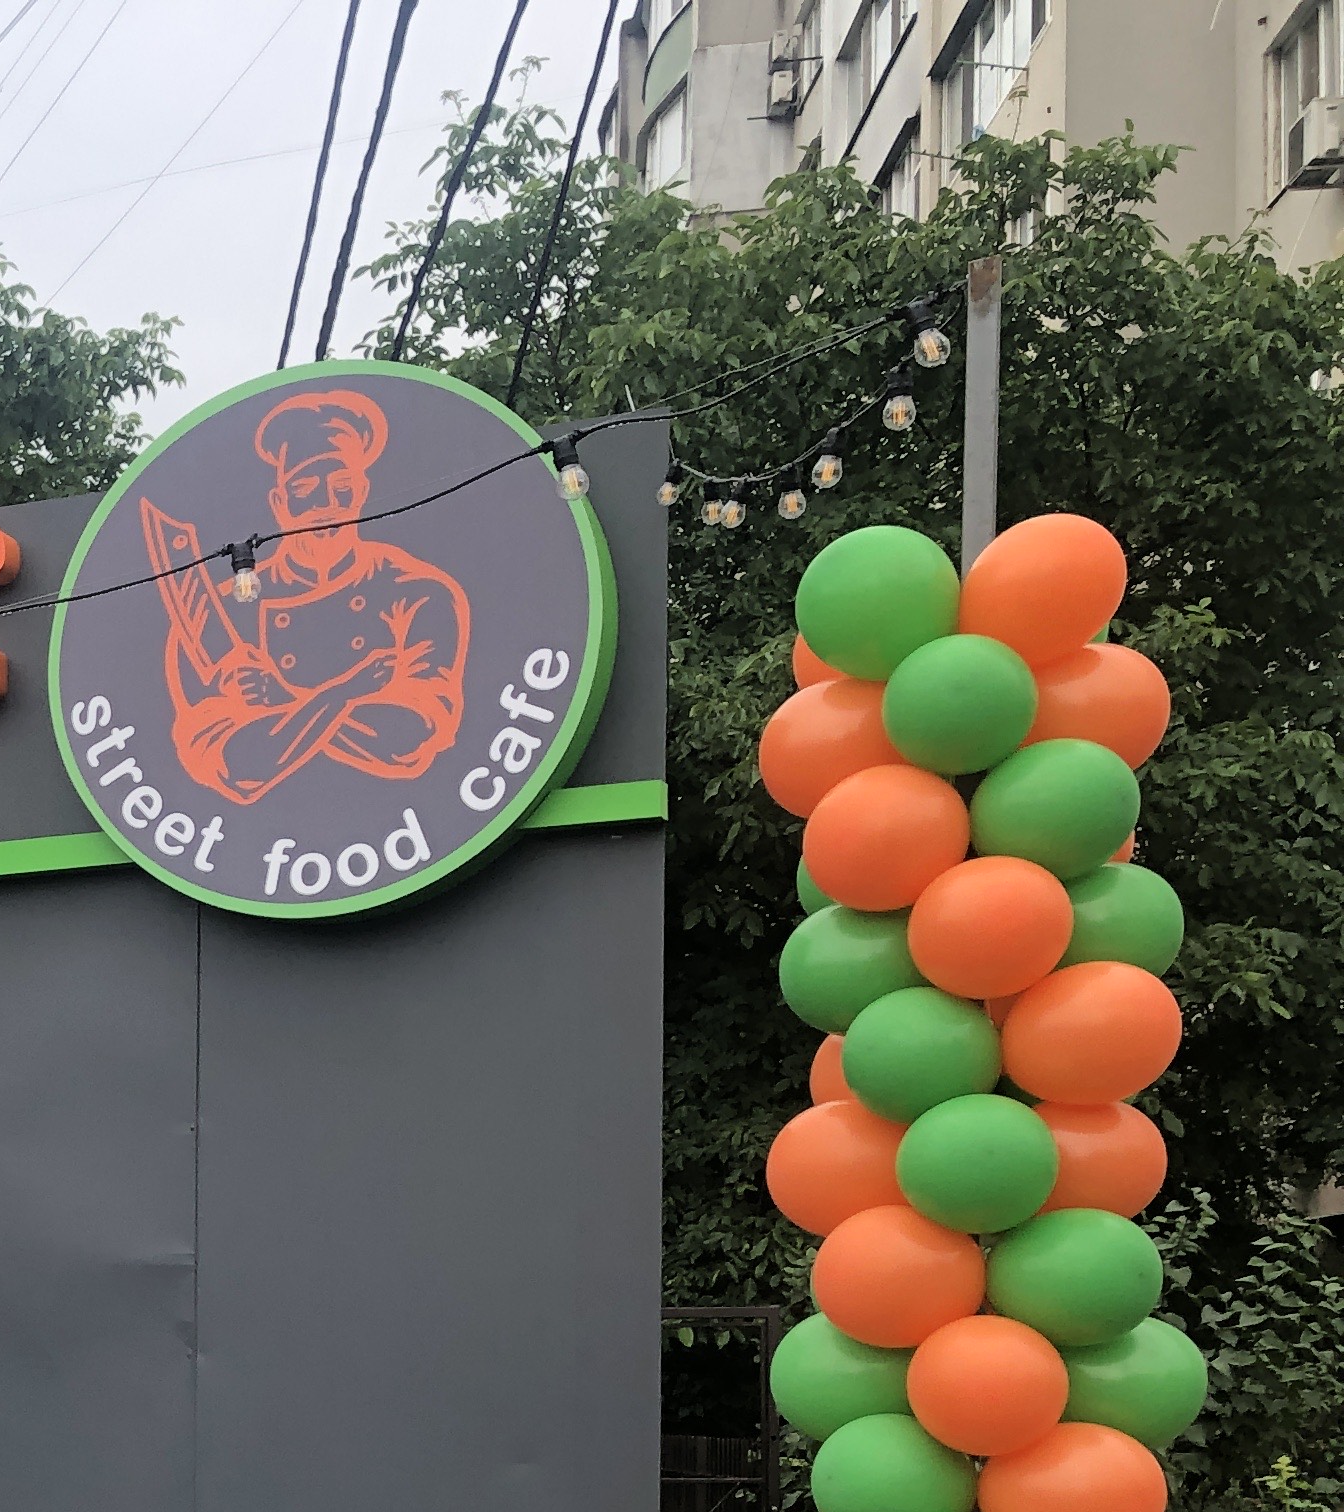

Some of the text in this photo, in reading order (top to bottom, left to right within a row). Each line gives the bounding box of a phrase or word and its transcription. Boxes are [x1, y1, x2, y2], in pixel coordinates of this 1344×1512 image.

[70, 647, 570, 896] street food cafe
